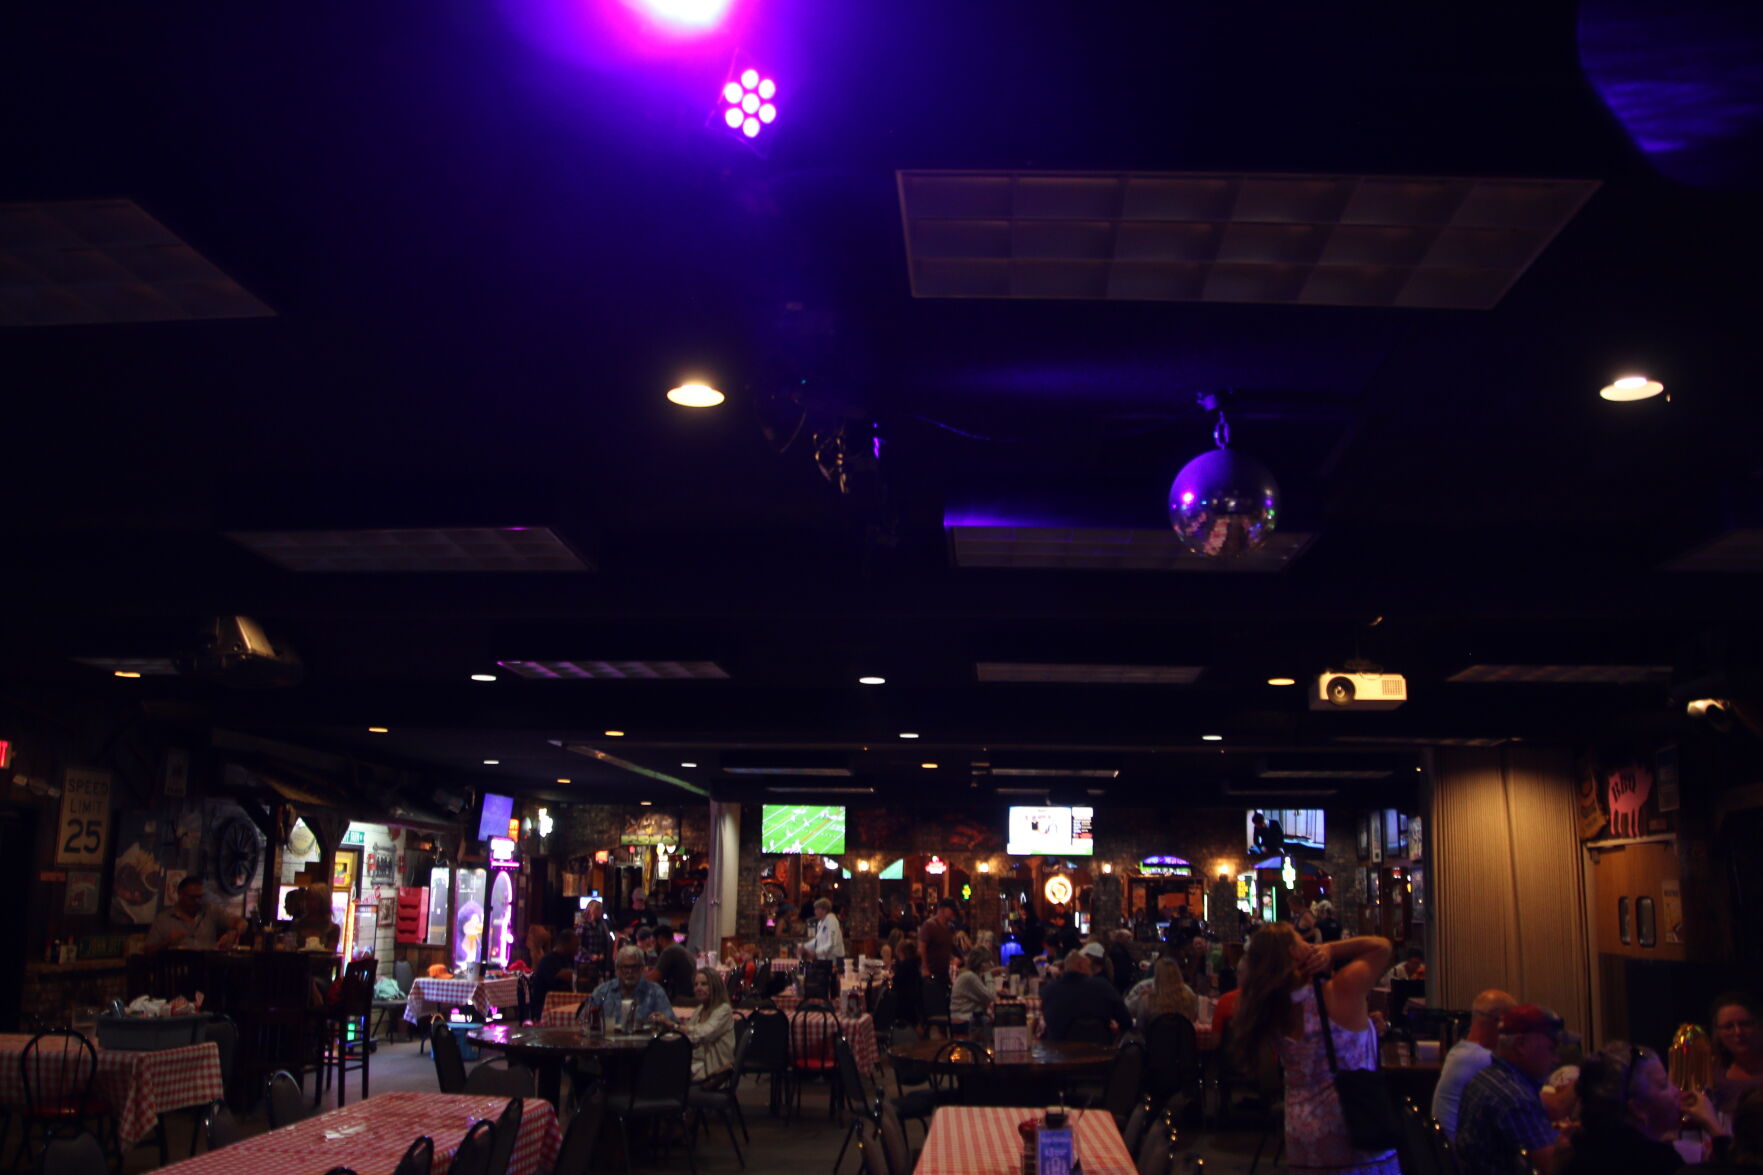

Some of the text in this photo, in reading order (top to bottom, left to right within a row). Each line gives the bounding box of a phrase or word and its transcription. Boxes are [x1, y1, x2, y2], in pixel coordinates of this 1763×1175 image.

[68, 778, 108, 793] SPEED
[1611, 773, 1636, 802] BBQ
[70, 799, 104, 815] LIMIT
[64, 818, 102, 854] 25
